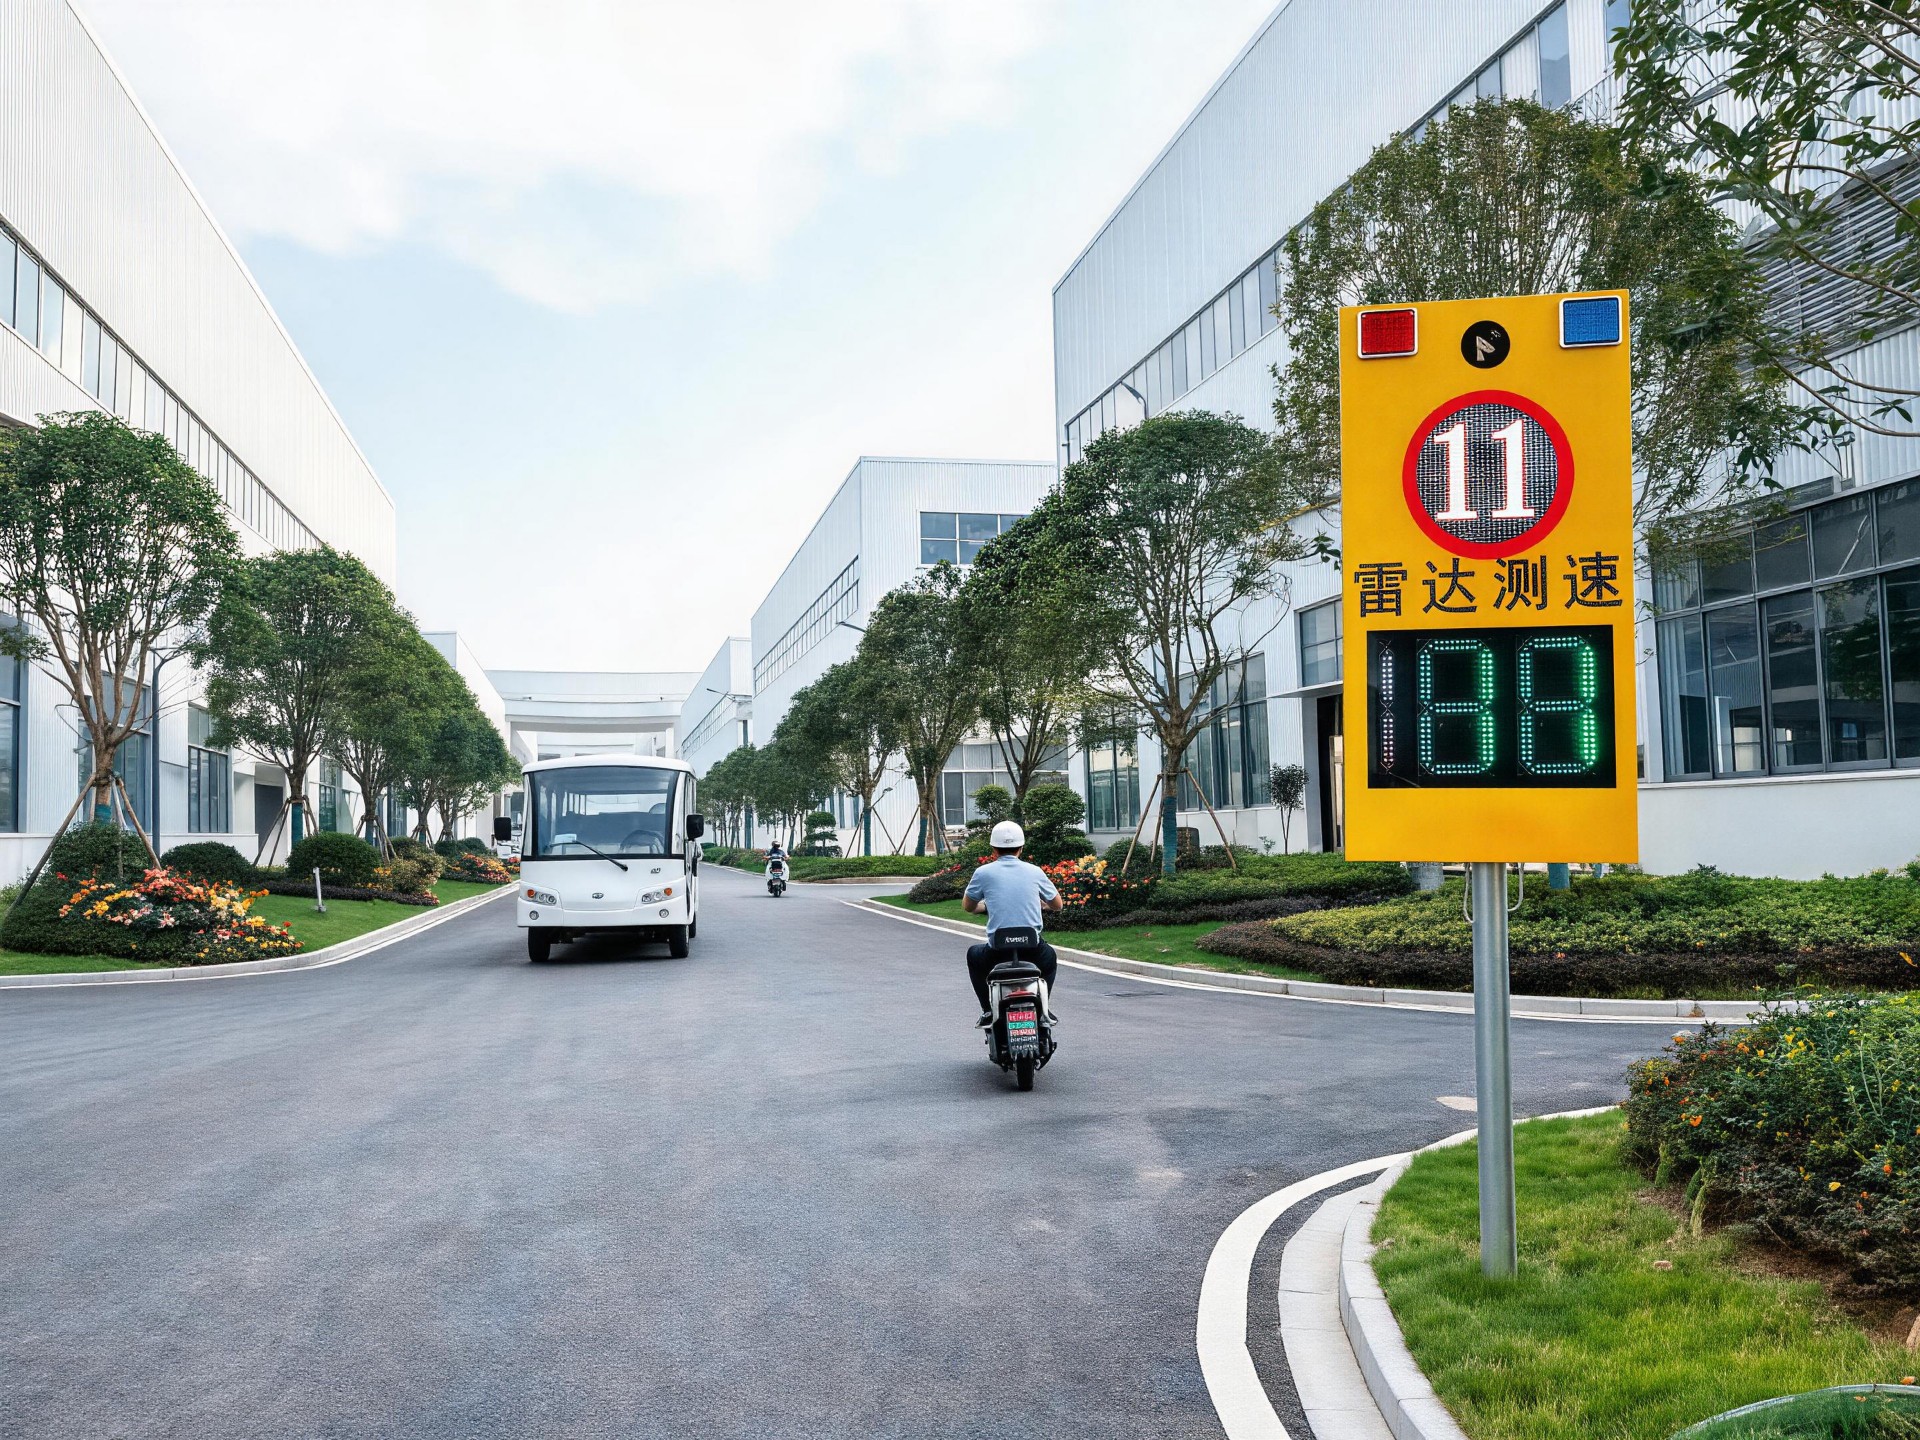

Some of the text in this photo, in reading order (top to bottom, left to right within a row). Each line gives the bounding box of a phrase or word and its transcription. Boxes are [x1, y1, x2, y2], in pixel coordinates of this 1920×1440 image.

[1433, 418, 1535, 521] 11
[1354, 551, 1623, 618] 雷达测速
